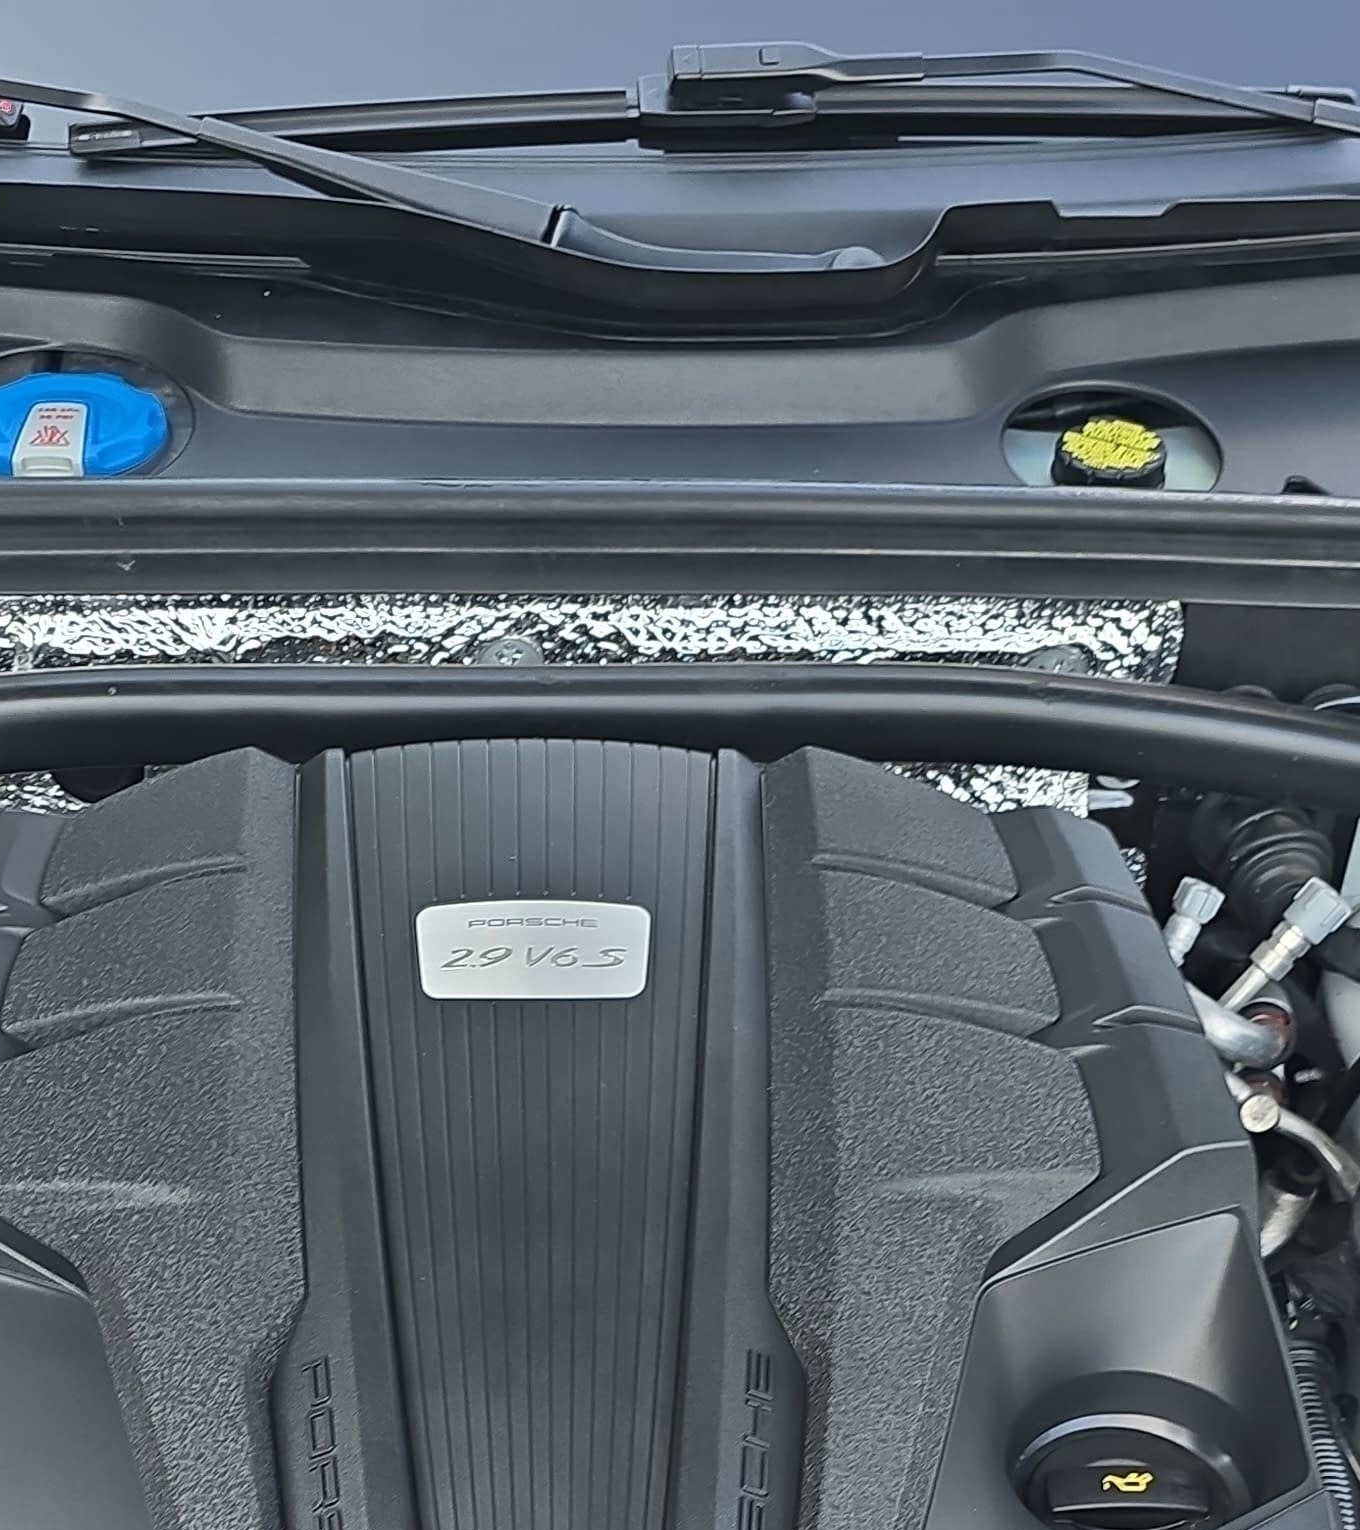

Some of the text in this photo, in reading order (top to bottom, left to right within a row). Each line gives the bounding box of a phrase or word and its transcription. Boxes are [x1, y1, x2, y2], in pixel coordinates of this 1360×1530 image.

[468, 917, 600, 929] PORSCHE
[440, 946, 628, 969] 2.9 V6 S
